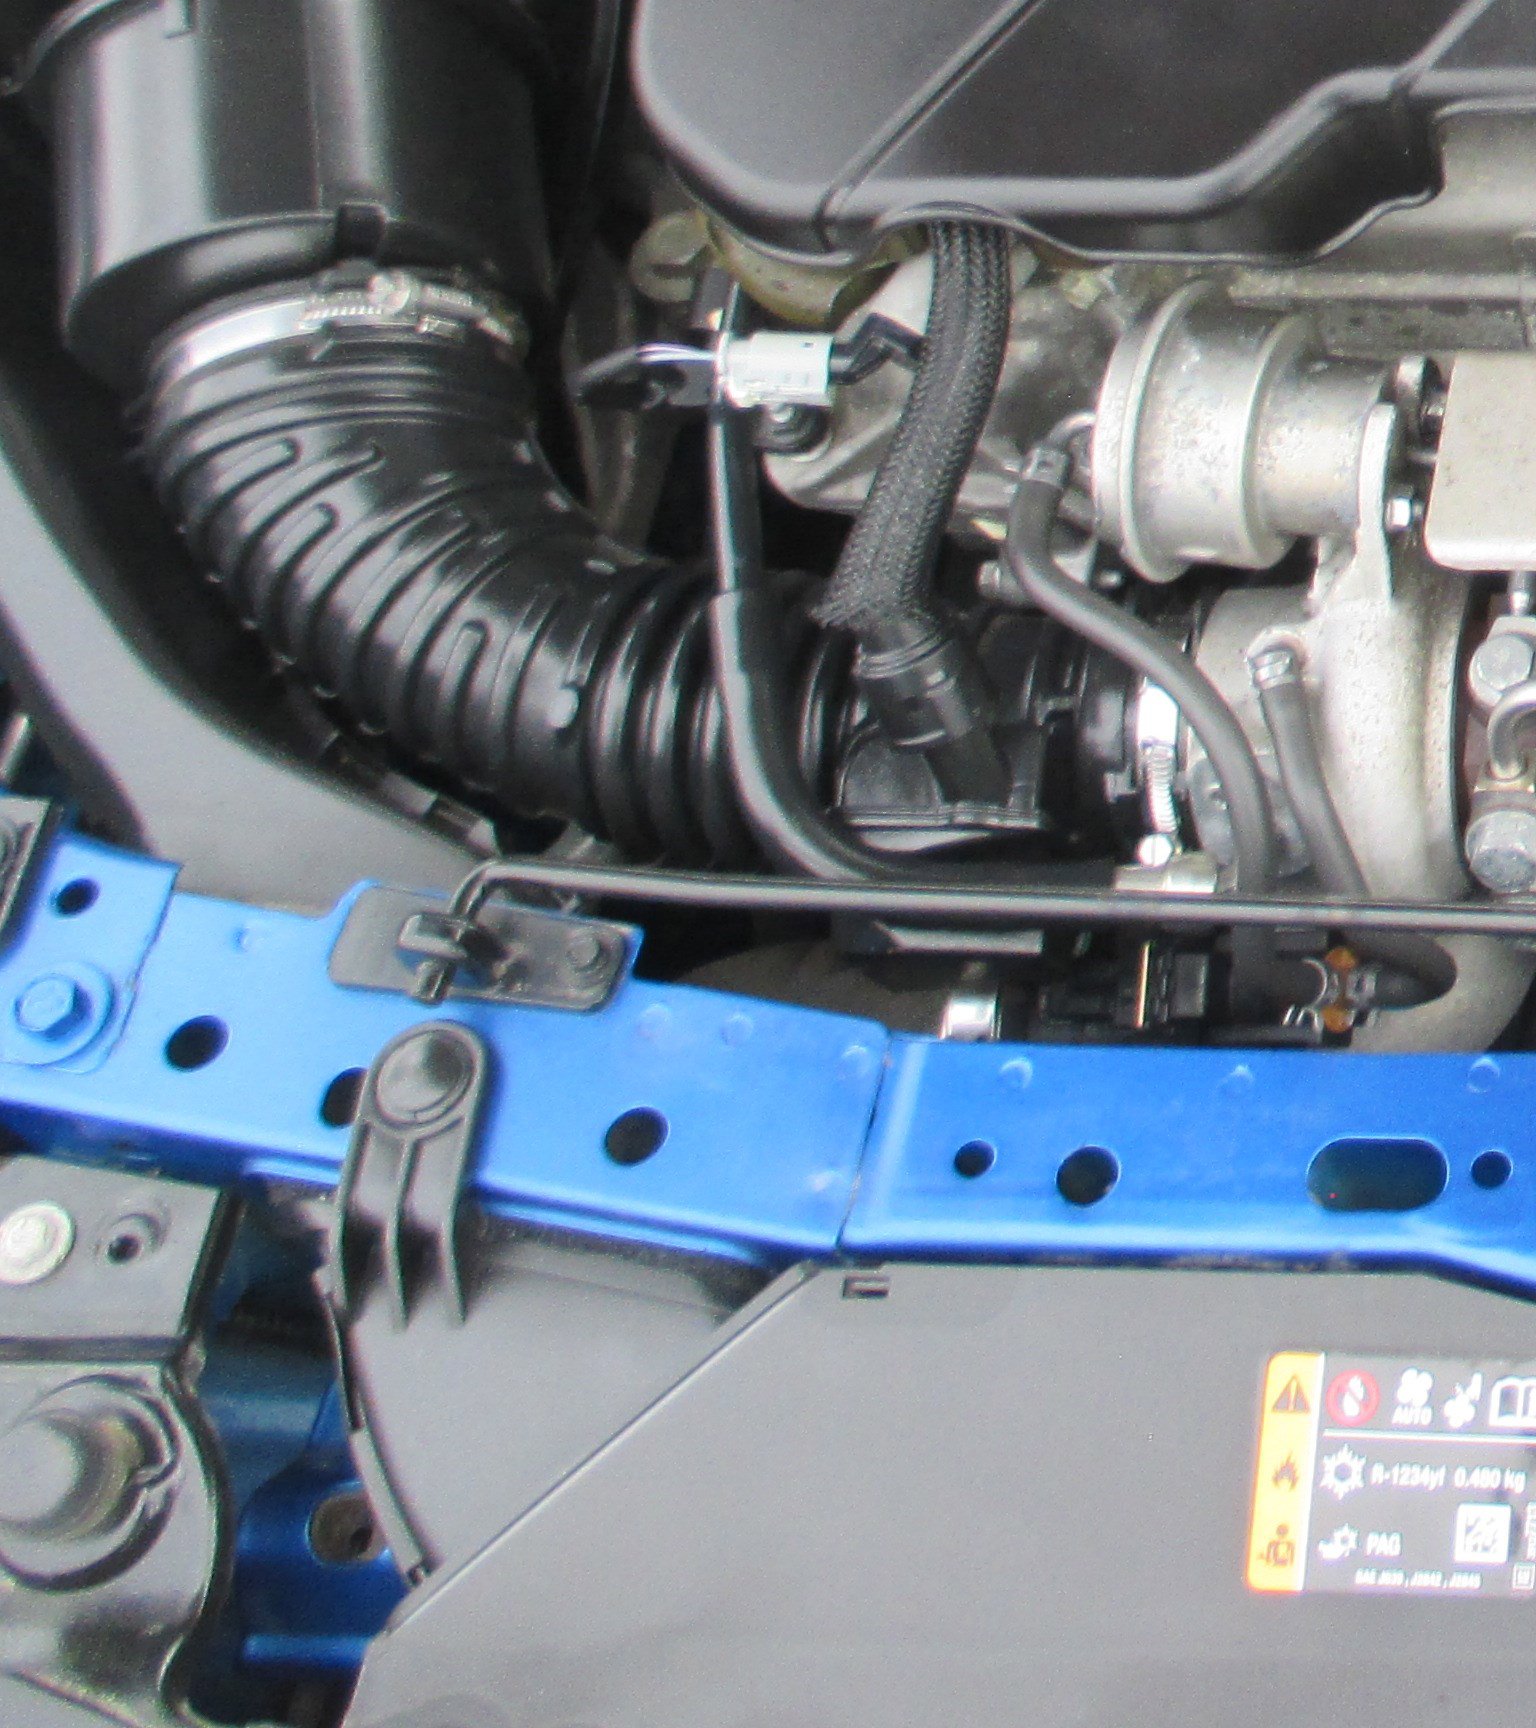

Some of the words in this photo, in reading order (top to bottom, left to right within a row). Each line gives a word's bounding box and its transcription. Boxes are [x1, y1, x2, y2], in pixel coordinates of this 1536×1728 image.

[1371, 1462, 1447, 1492] R-1234yf
[1504, 1467, 1527, 1494] kg
[1366, 1533, 1402, 1557] PAG
